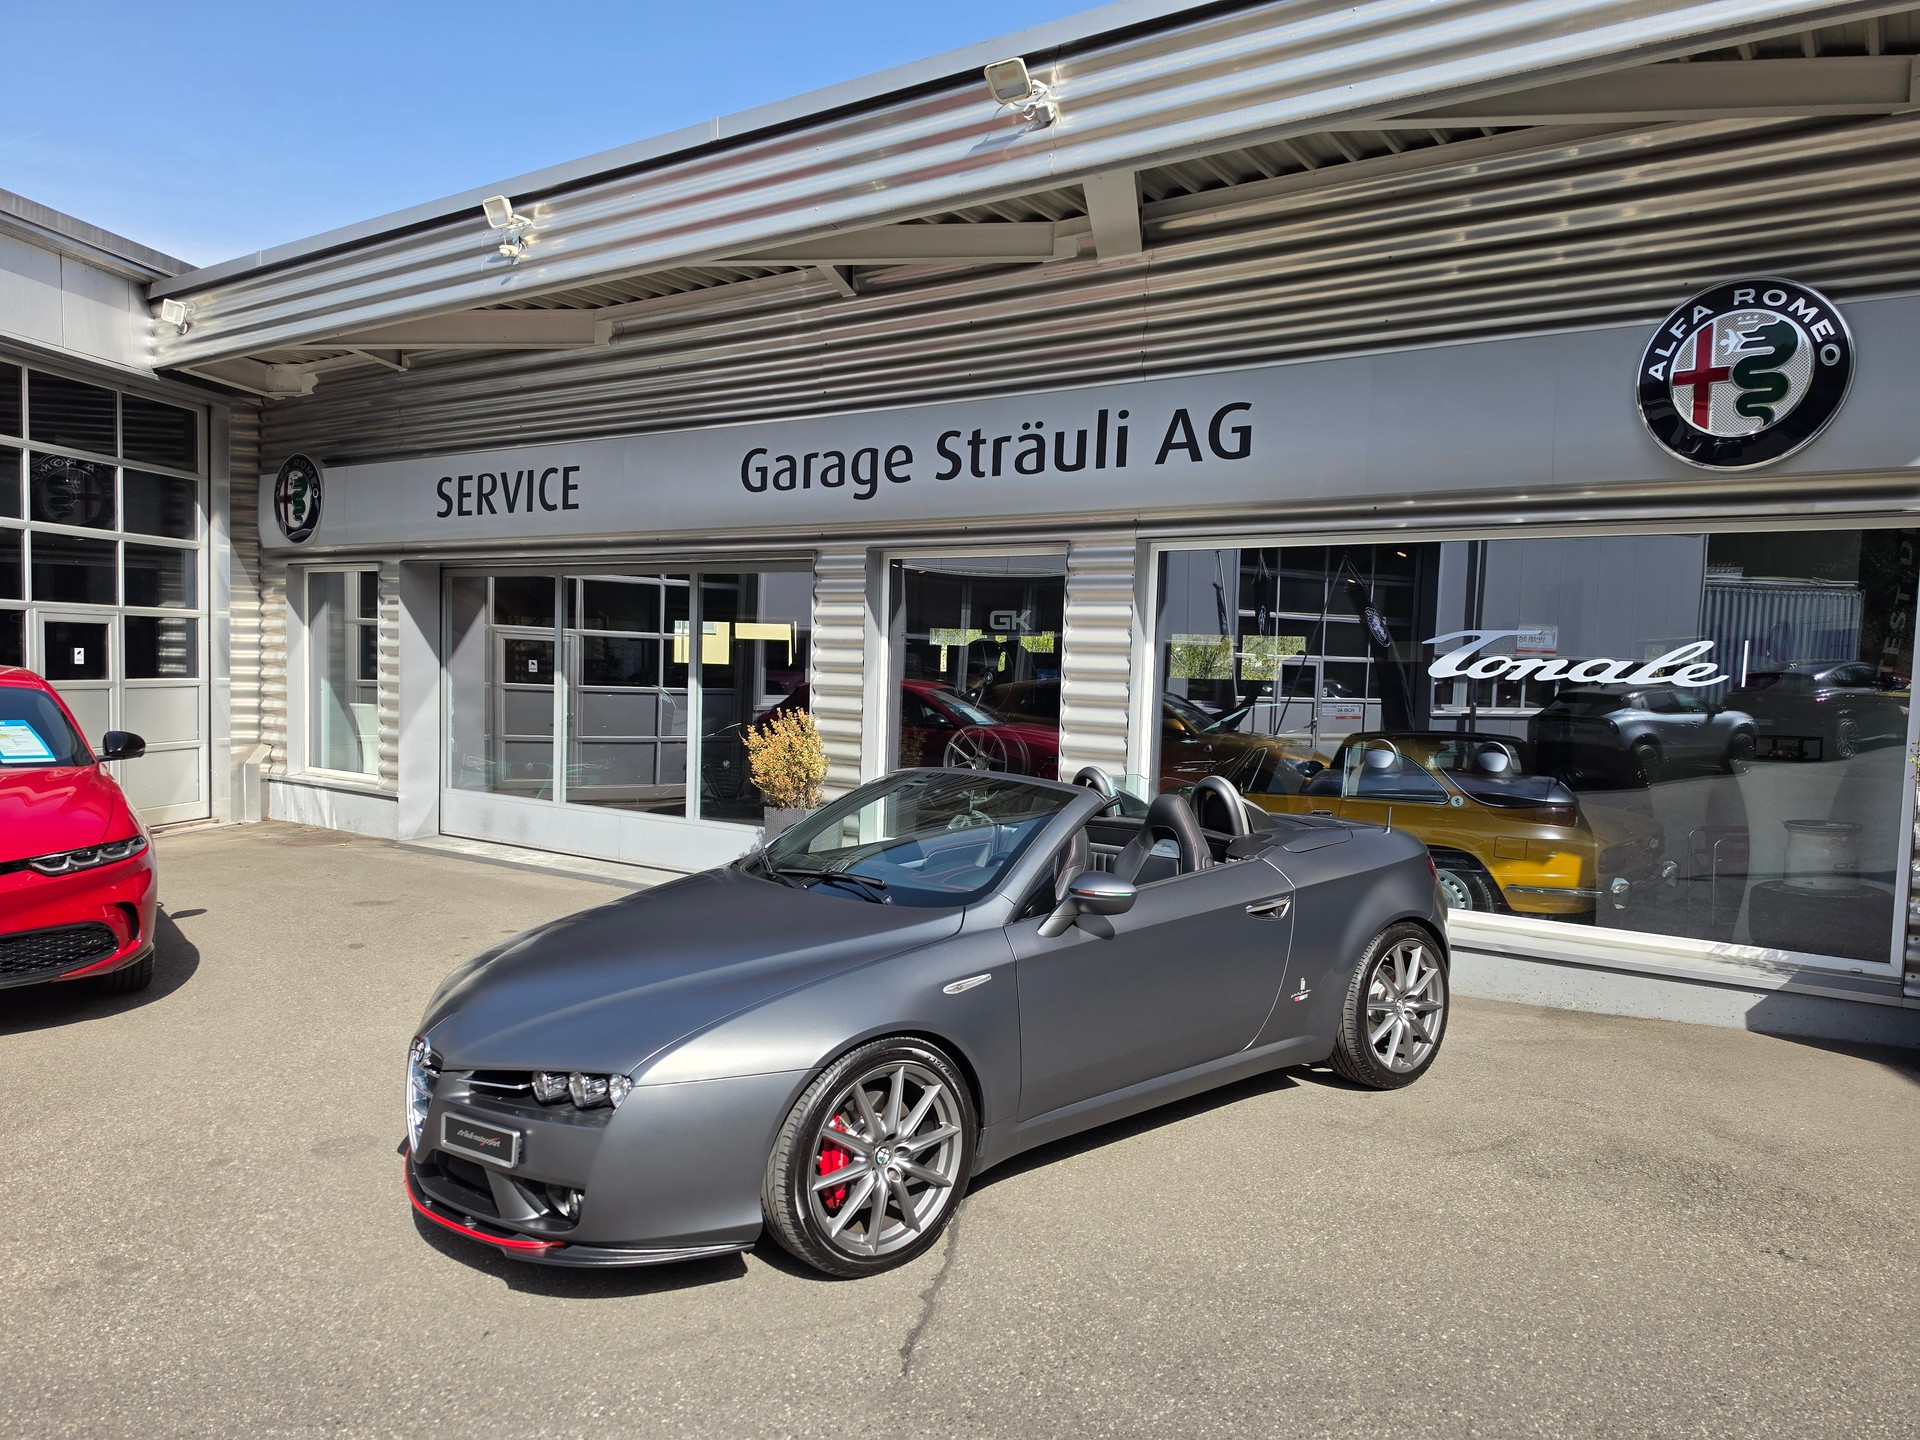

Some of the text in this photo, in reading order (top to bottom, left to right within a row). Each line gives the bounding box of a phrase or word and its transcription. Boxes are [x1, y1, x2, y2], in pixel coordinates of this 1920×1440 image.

[1648, 288, 1841, 382] ALFA ROMEO
[741, 401, 1253, 500] Garage Sträuli AG
[436, 465, 581, 518] SERVICE
[989, 609, 1032, 630] GK
[1876, 586, 1911, 678] TEST
[1422, 630, 1729, 687] Tonale
